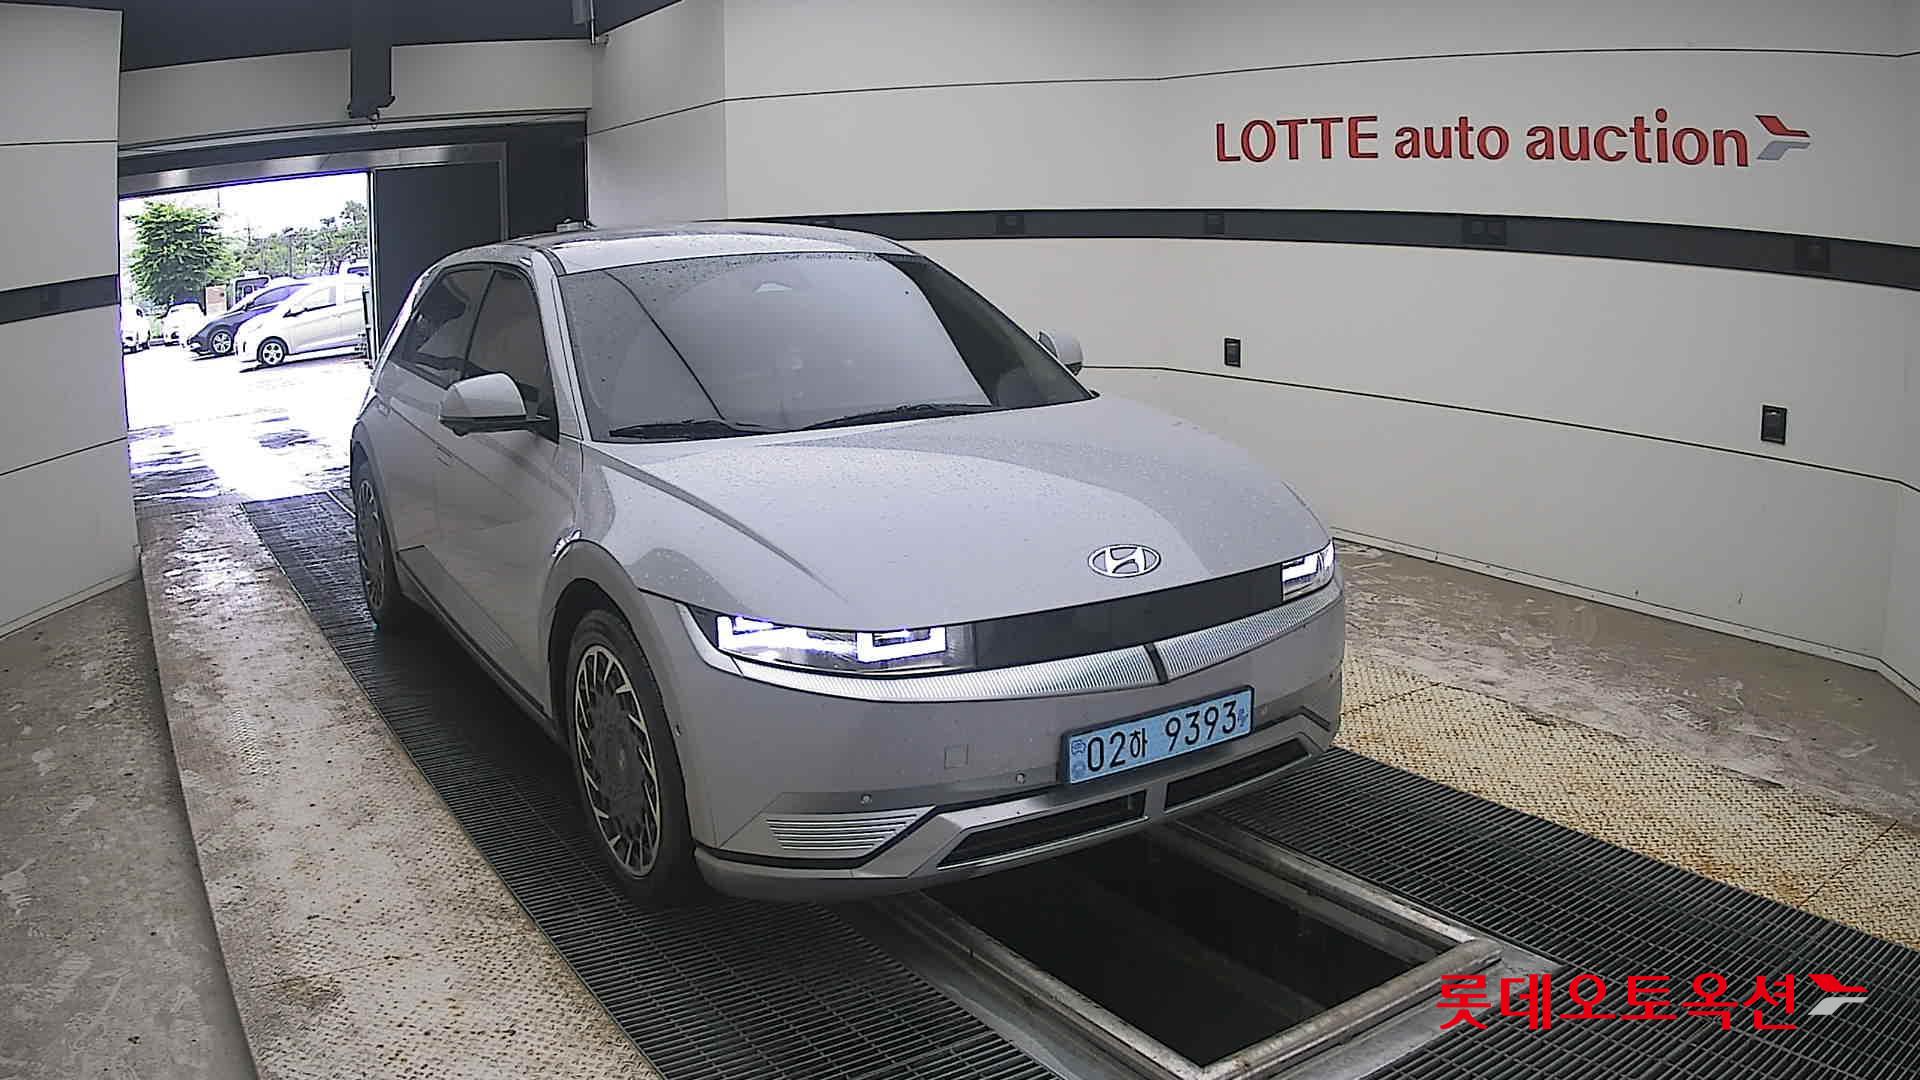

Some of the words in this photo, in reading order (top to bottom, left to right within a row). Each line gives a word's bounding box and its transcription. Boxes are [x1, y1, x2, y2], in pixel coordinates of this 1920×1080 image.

[1216, 115, 1378, 162] LOTTE
[1394, 116, 1509, 160] auto
[1526, 108, 1748, 167] auction
[1087, 728, 1148, 771] 02하
[1165, 700, 1237, 752] 9393
